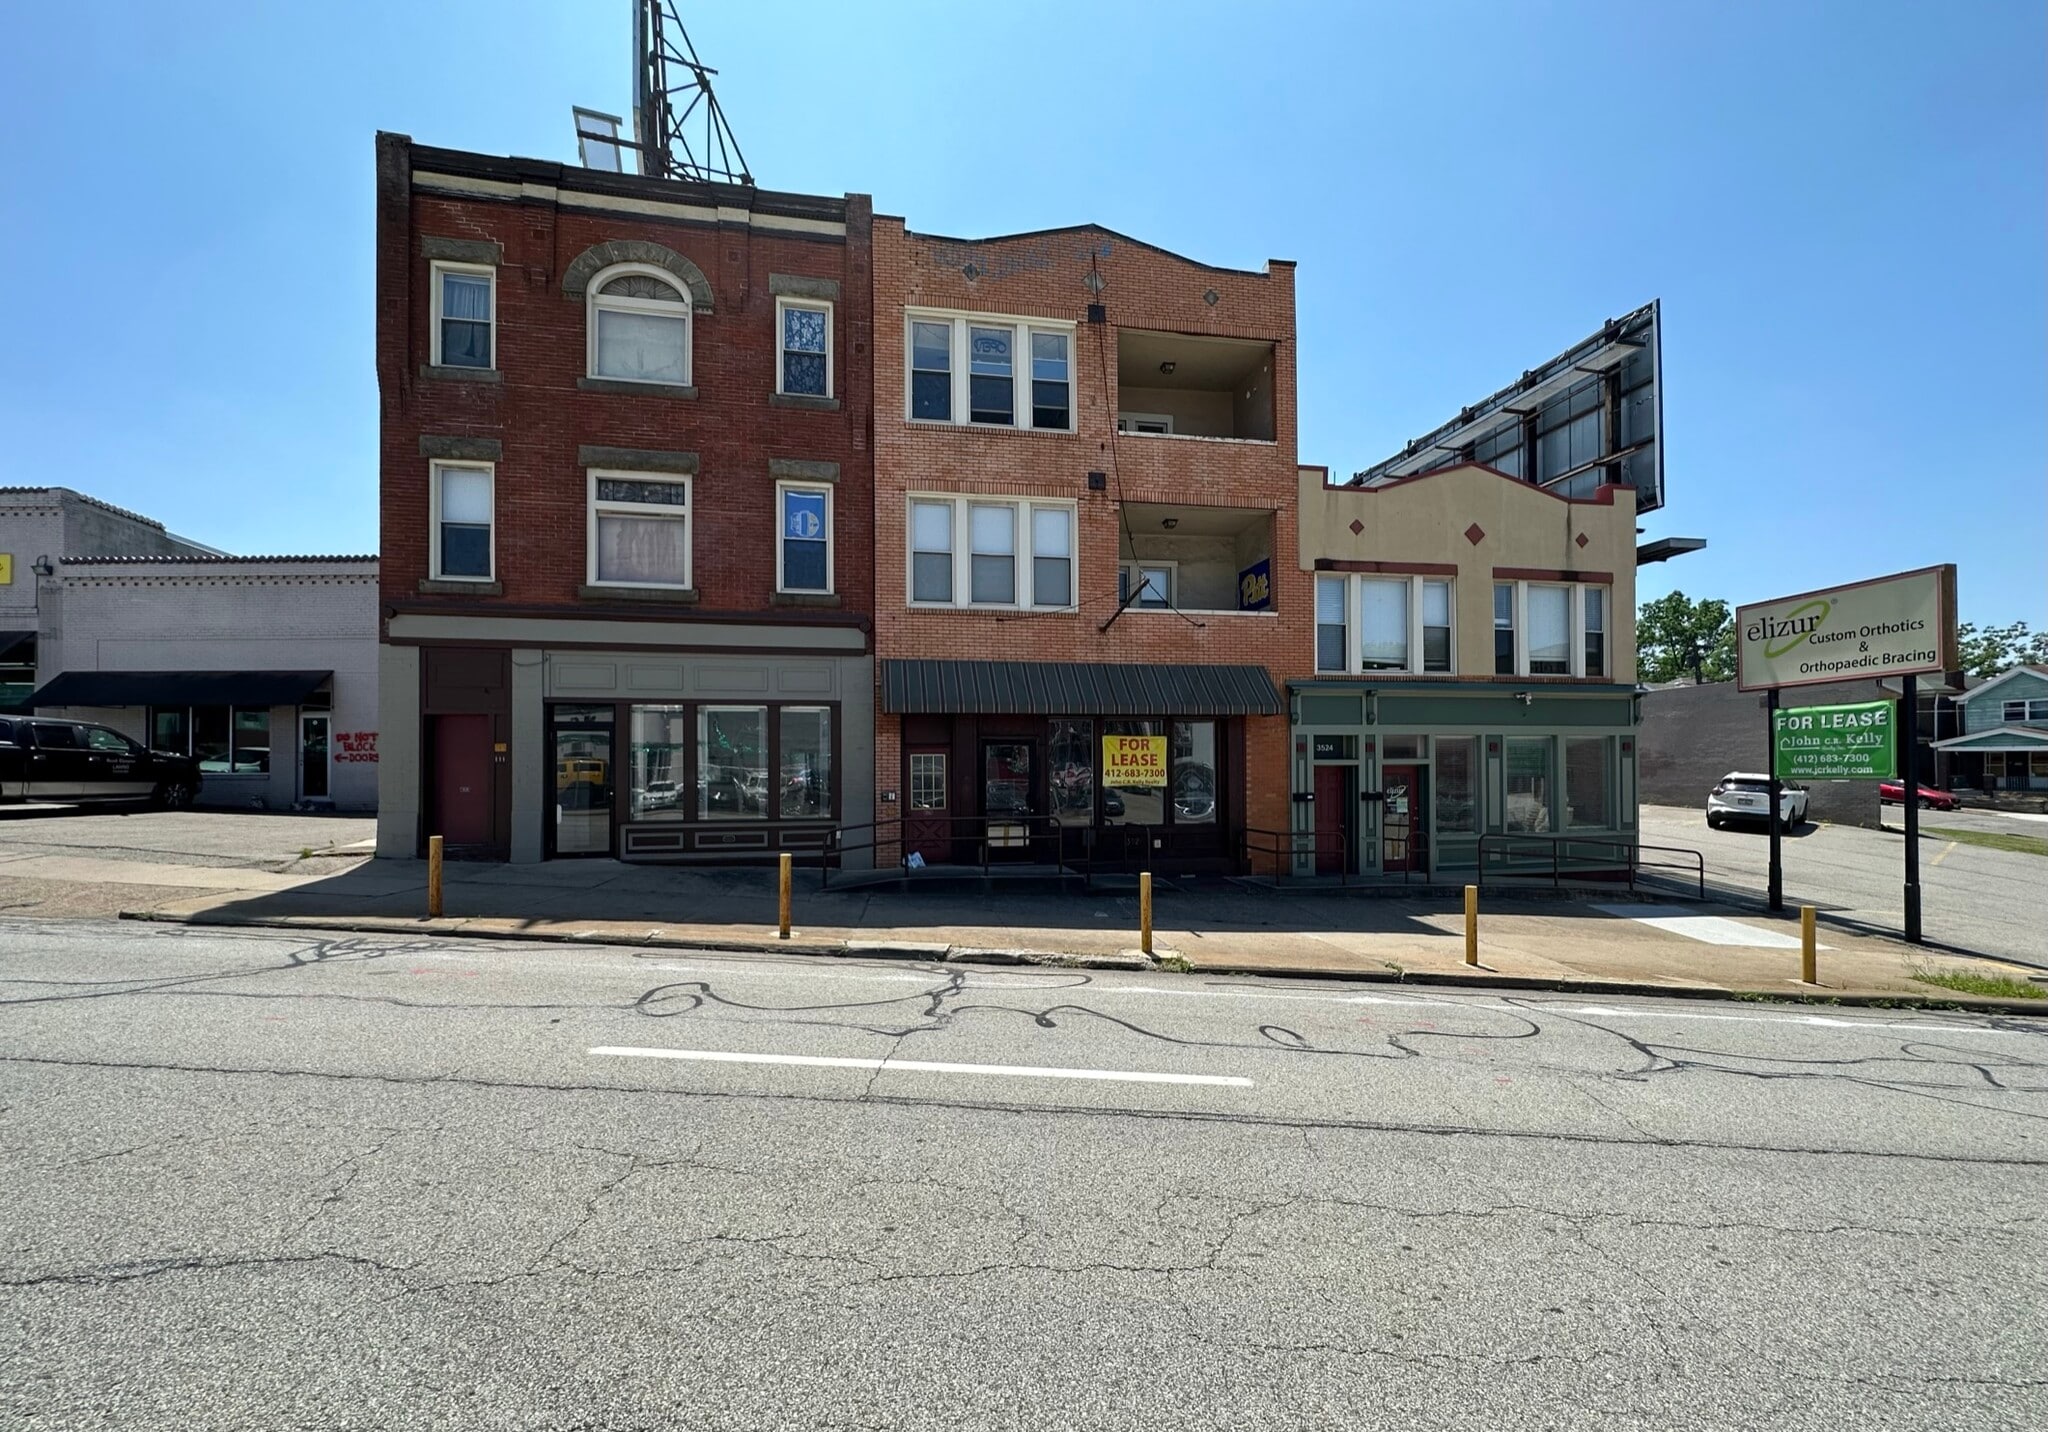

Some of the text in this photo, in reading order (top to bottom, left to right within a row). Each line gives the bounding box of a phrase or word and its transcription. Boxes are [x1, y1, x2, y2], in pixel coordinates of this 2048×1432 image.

[1809, 619, 1925, 645] Custom Orthotics
[1859, 641, 1869, 653] &
[1800, 649, 1936, 673] Orthopaedic Bracing
[1777, 710, 1888, 730] FOR LEASE
[335, 731, 379, 743] DO NOT
[1791, 735, 1820, 746] John
[1846, 732, 1883, 744] Kelly
[343, 741, 376, 752] BLOCK
[1119, 738, 1150, 751] FOR
[1316, 744, 1334, 752] 3524
[349, 753, 379, 763] DOORS
[1111, 754, 1158, 766] LEASE
[1793, 753, 1870, 764] (412) 683-7300
[1105, 769, 1165, 778] 412-683-7300
[1791, 765, 1873, 775] www.jcrkelly.com
